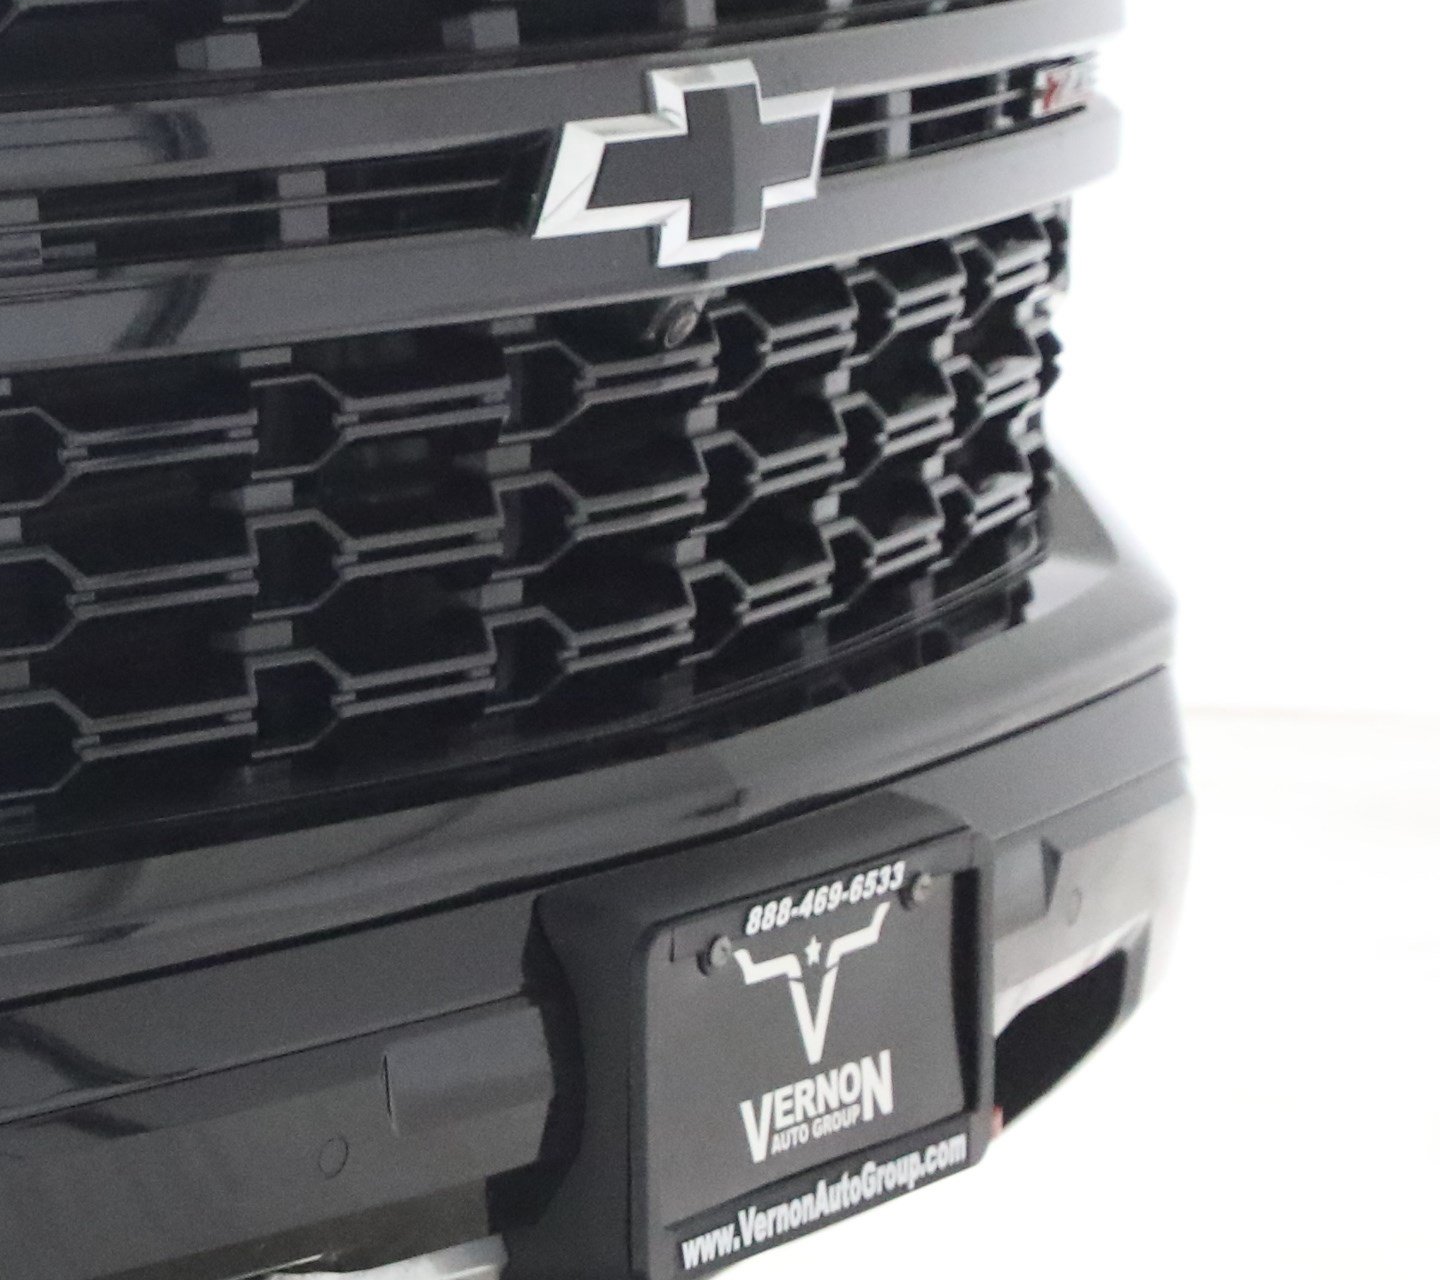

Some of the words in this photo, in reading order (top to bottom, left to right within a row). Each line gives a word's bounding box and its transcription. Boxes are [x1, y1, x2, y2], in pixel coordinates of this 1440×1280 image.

[745, 860, 907, 936] 888-469-6533
[739, 1049, 894, 1164] VERNON
[770, 1128, 810, 1155] AUTO
[812, 1103, 861, 1137] GROUP
[681, 1132, 968, 1270] www.VernonAutoGroup.com
